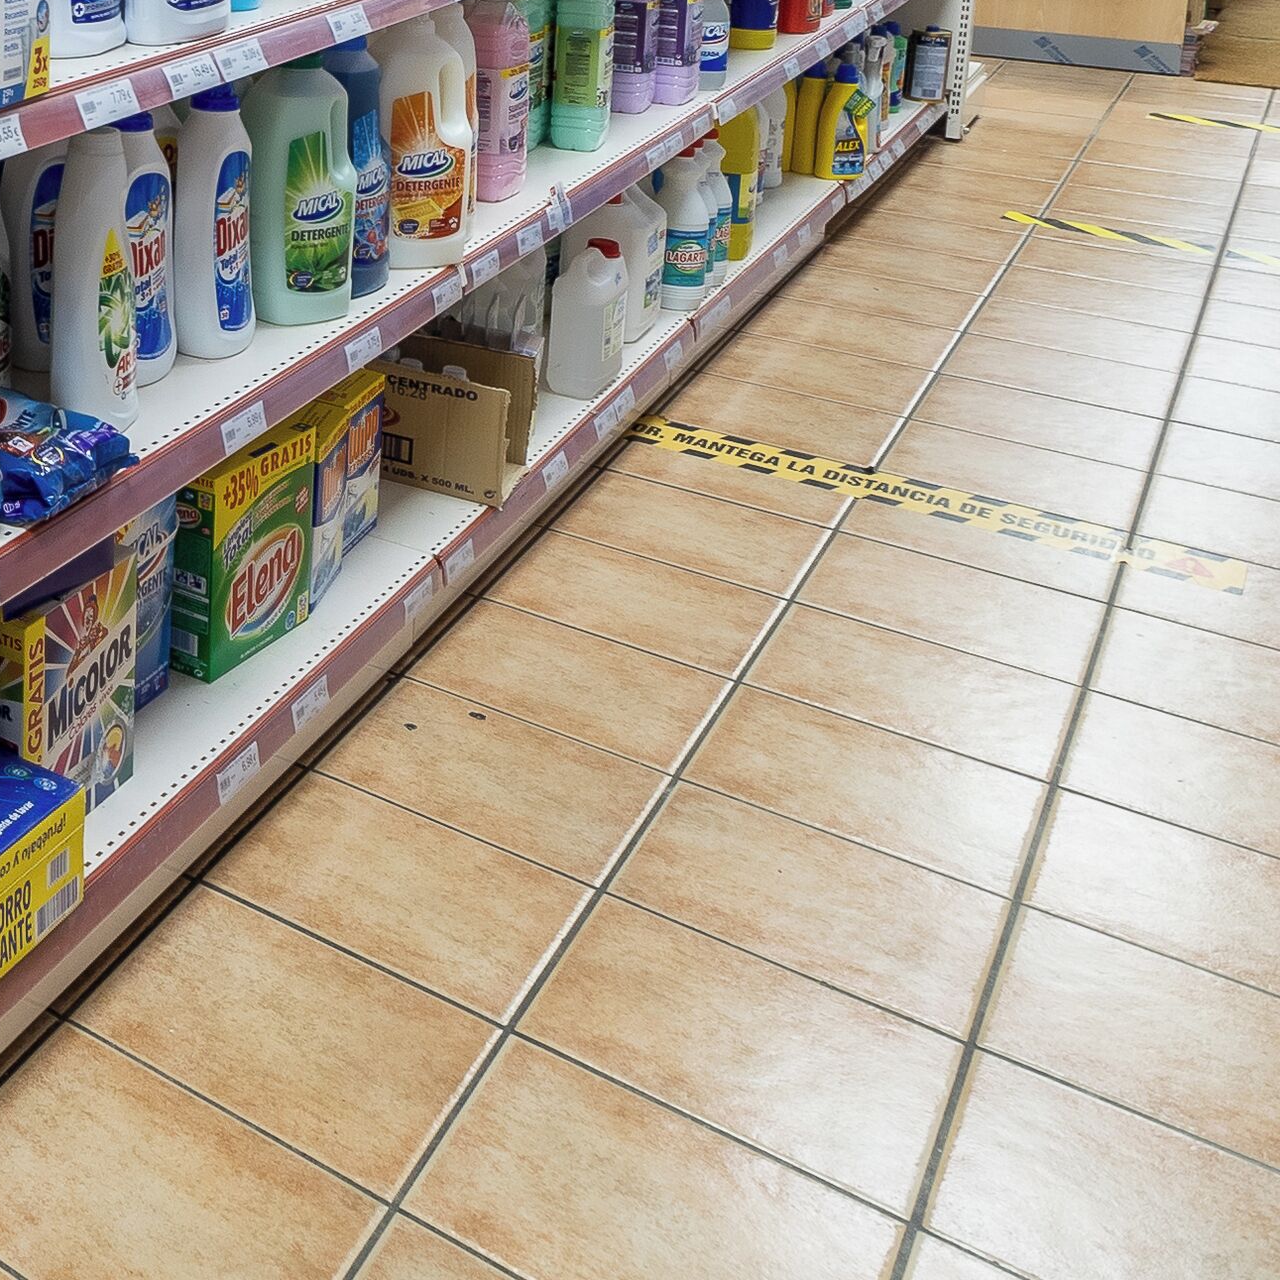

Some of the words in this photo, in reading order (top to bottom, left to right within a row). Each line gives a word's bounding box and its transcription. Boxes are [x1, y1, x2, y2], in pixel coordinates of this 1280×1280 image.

[34, 47, 48, 75] 3x
[836, 137, 861, 153] ALEX
[401, 149, 447, 172] MICAL
[396, 177, 461, 193] DETERGENTE
[297, 191, 340, 218] MICAL
[291, 223, 349, 243] DETERGENTE
[387, 374, 478, 402] CENTRADO
[261, 433, 313, 478] GRATIS
[432, 476, 452, 490] 500
[455, 482, 475, 496] ML.
[674, 429, 780, 466] MANTEGA
[787, 460, 817, 477] LA
[824, 468, 952, 510] DISTANCIA
[958, 501, 992, 521] DE
[223, 469, 260, 510] +35%
[229, 527, 302, 641] Elena
[27, 637, 44, 755] GRATIS
